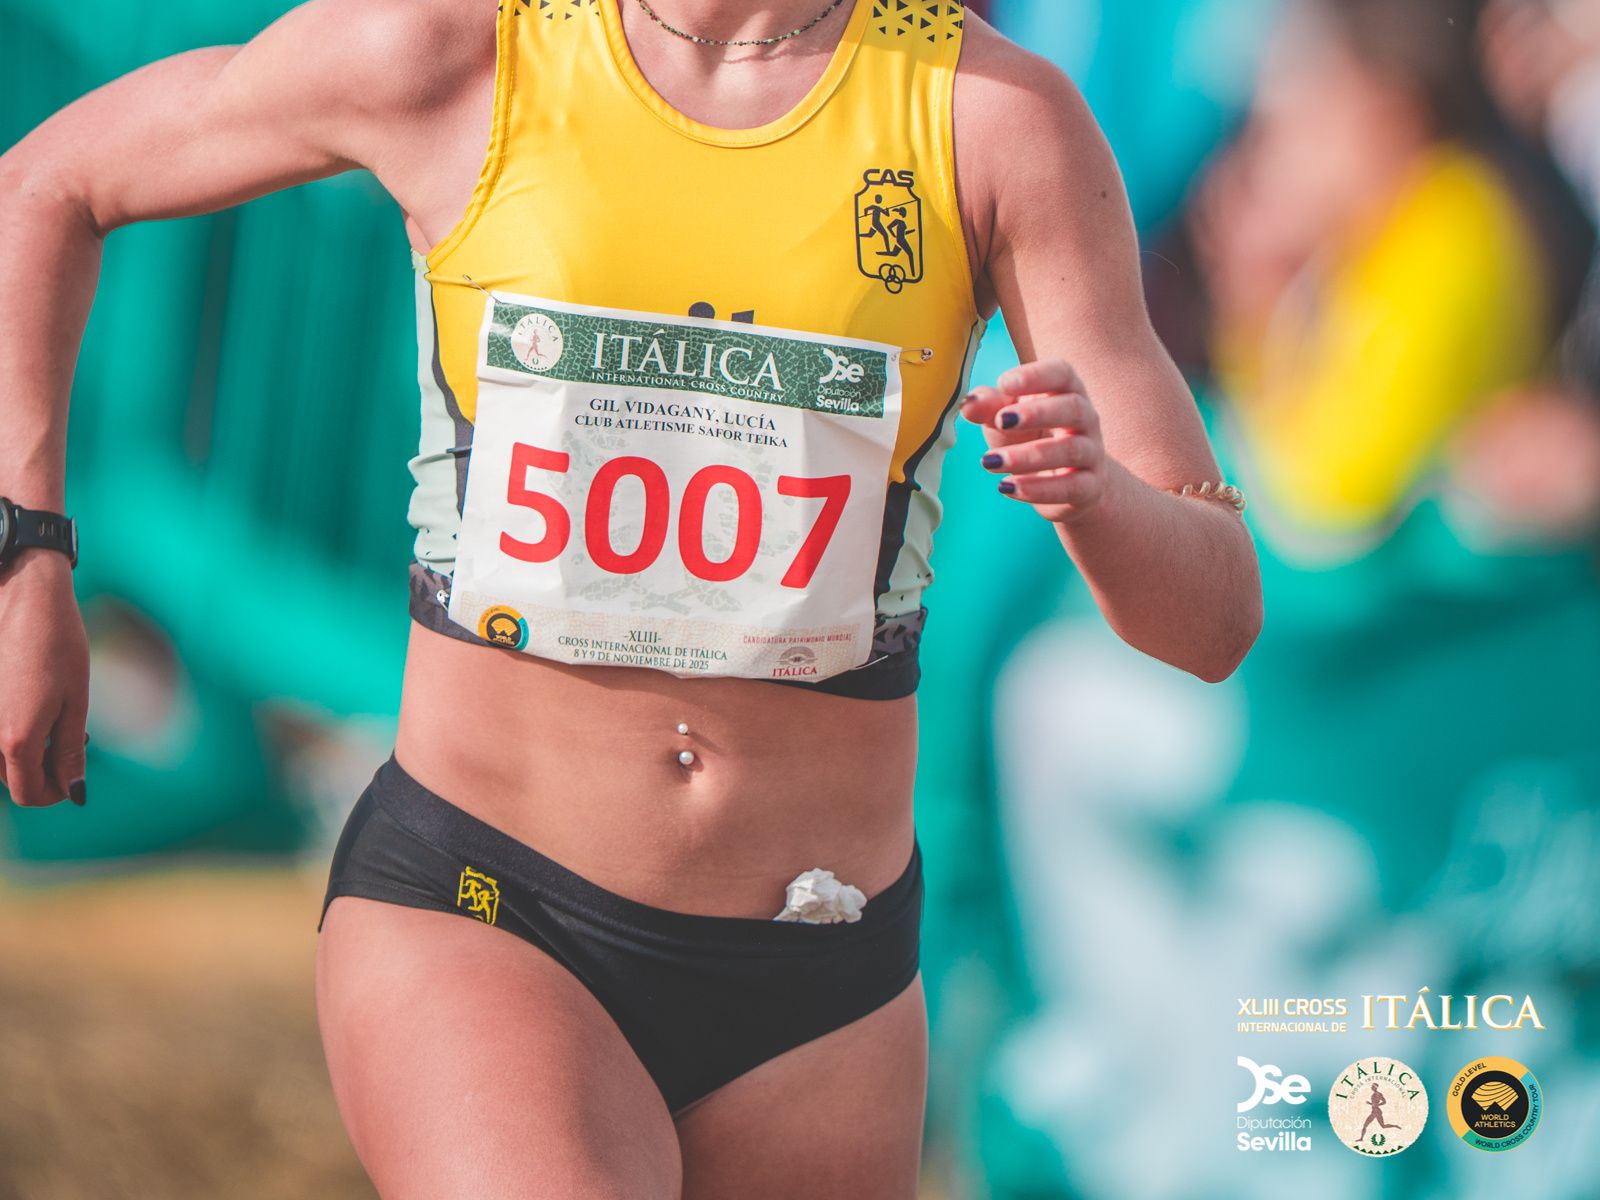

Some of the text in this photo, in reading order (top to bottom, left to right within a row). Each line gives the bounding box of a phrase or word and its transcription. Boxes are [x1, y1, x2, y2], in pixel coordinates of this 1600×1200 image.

[863, 168, 915, 187] CAS
[591, 329, 785, 391] ITÁLICA
[591, 371, 785, 402] INTERNATIONAL CROSS COUNTRY
[817, 385, 862, 398] Diputación
[590, 398, 776, 431] GIL VIDAGANY, LUCÍA
[816, 395, 860, 412] Sevilla
[575, 415, 788, 448] CLUB ATLETISME SAFOR TEIKA
[499, 441, 852, 589] 5007
[558, 635, 727, 660] CROSS INTERNACIONAL DE ITÁLICA
[624, 630, 662, 644] -XLIII-
[574, 648, 709, 670] 8 Y 9 DE NOVIEMBRE DE 2025
[772, 666, 818, 677] ITÁLICA
